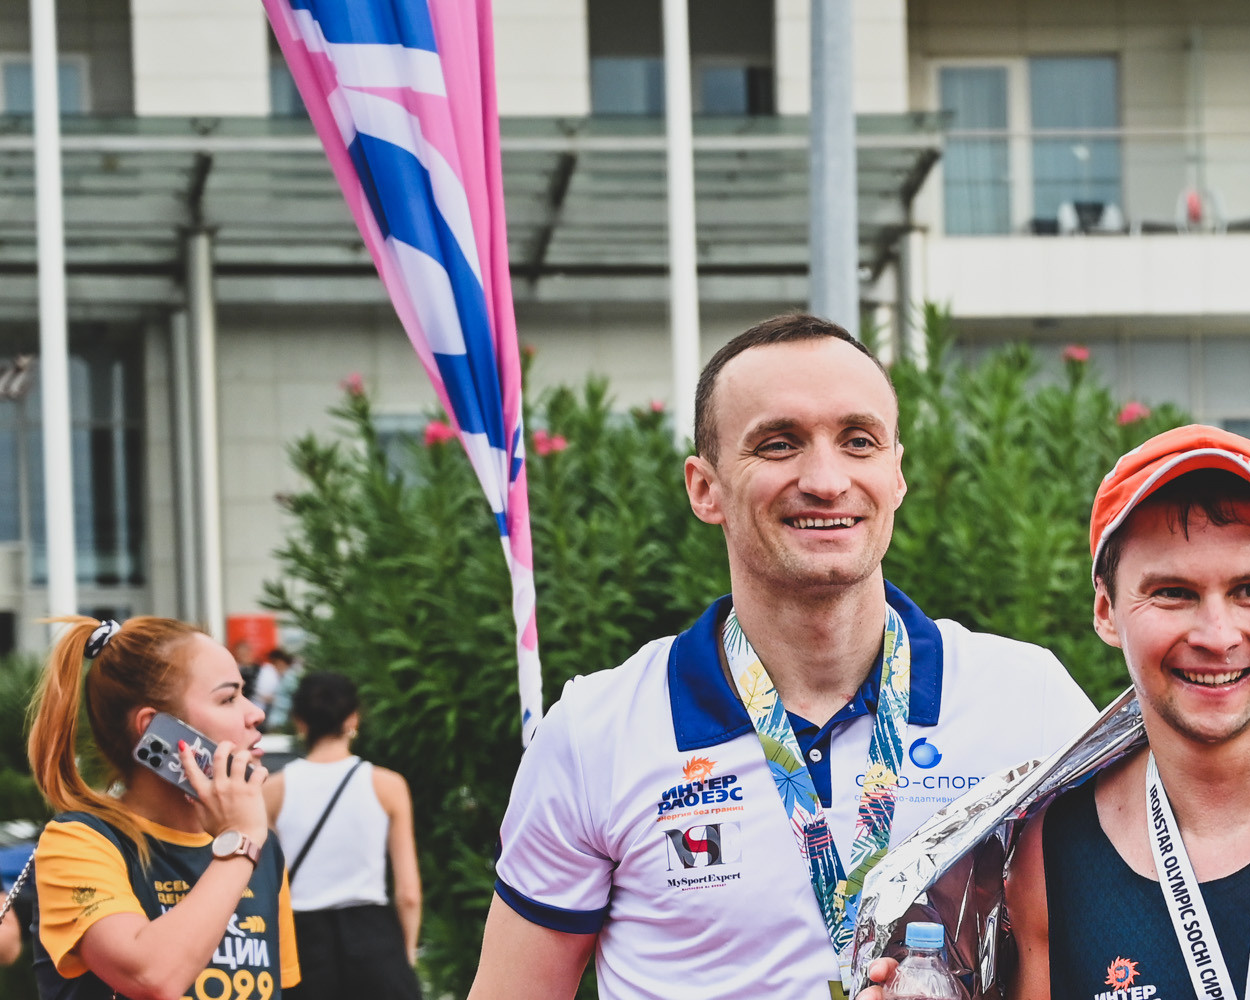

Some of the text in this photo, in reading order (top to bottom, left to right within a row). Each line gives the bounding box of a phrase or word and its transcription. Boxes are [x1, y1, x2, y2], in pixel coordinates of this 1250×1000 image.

[662, 774, 738, 802] ИНТЕР
[667, 872, 742, 888] MySportExpert
[1150, 784, 1174, 857] IRONSTAR
[1163, 855, 1196, 921] OLYMPIC
[1183, 920, 1212, 968] SOCHI
